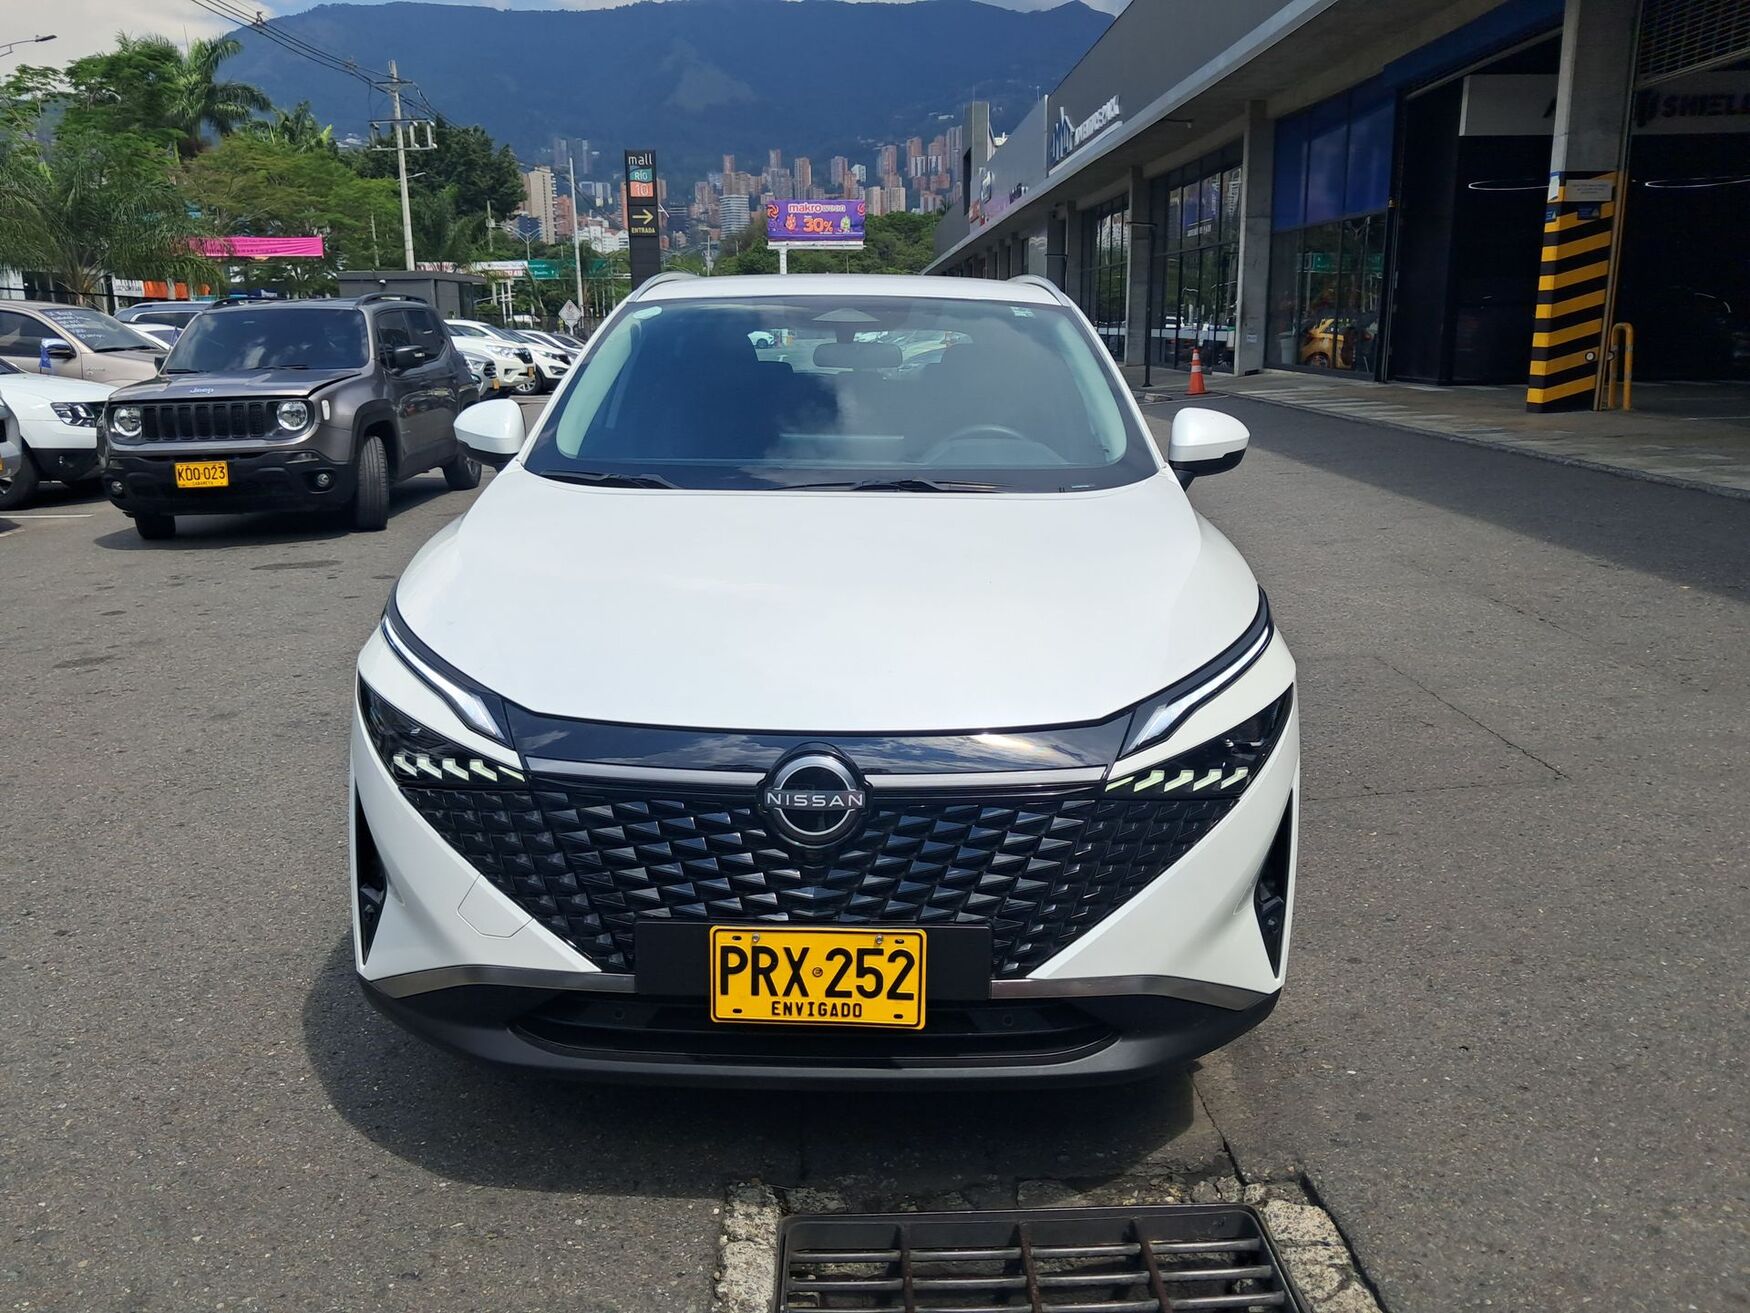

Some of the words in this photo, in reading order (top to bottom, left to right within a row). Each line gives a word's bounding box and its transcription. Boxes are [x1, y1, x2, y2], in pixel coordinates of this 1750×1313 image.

[628, 153, 653, 166] mall
[635, 184, 649, 197] 10
[803, 217, 833, 232] 30%
[767, 792, 863, 807] NISSAN
[771, 1000, 862, 1018] ENVIGADO
